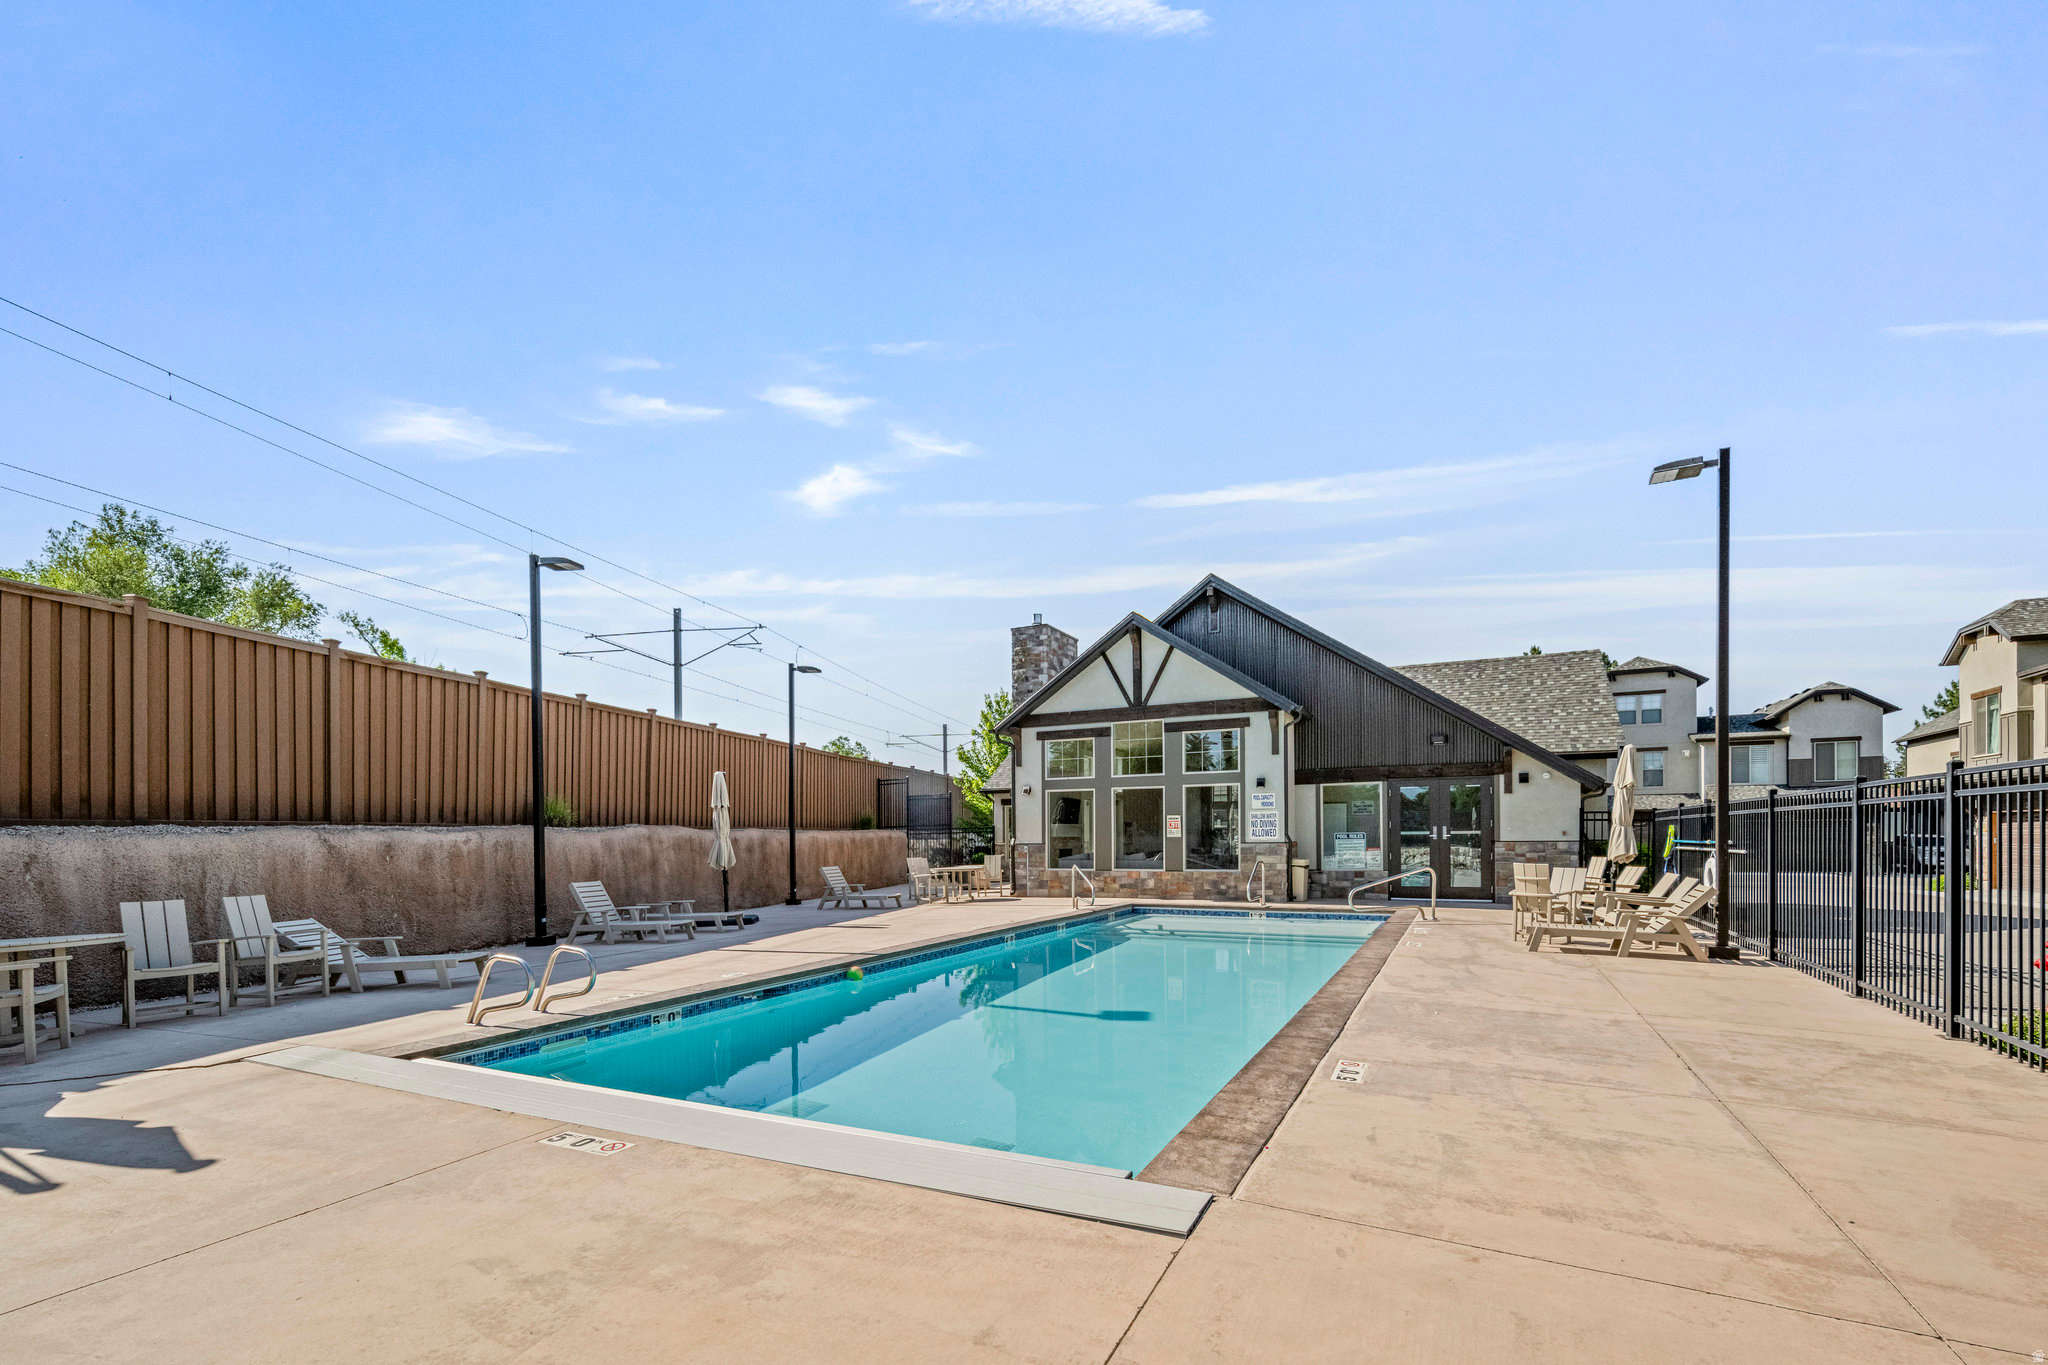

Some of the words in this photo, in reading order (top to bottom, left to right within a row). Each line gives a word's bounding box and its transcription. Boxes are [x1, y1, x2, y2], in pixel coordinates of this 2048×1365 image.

[1252, 829, 1277, 837] ALLOWED
[653, 1015, 660, 1024] 5
[547, 1133, 574, 1142] 5
[570, 1137, 596, 1147] 0
